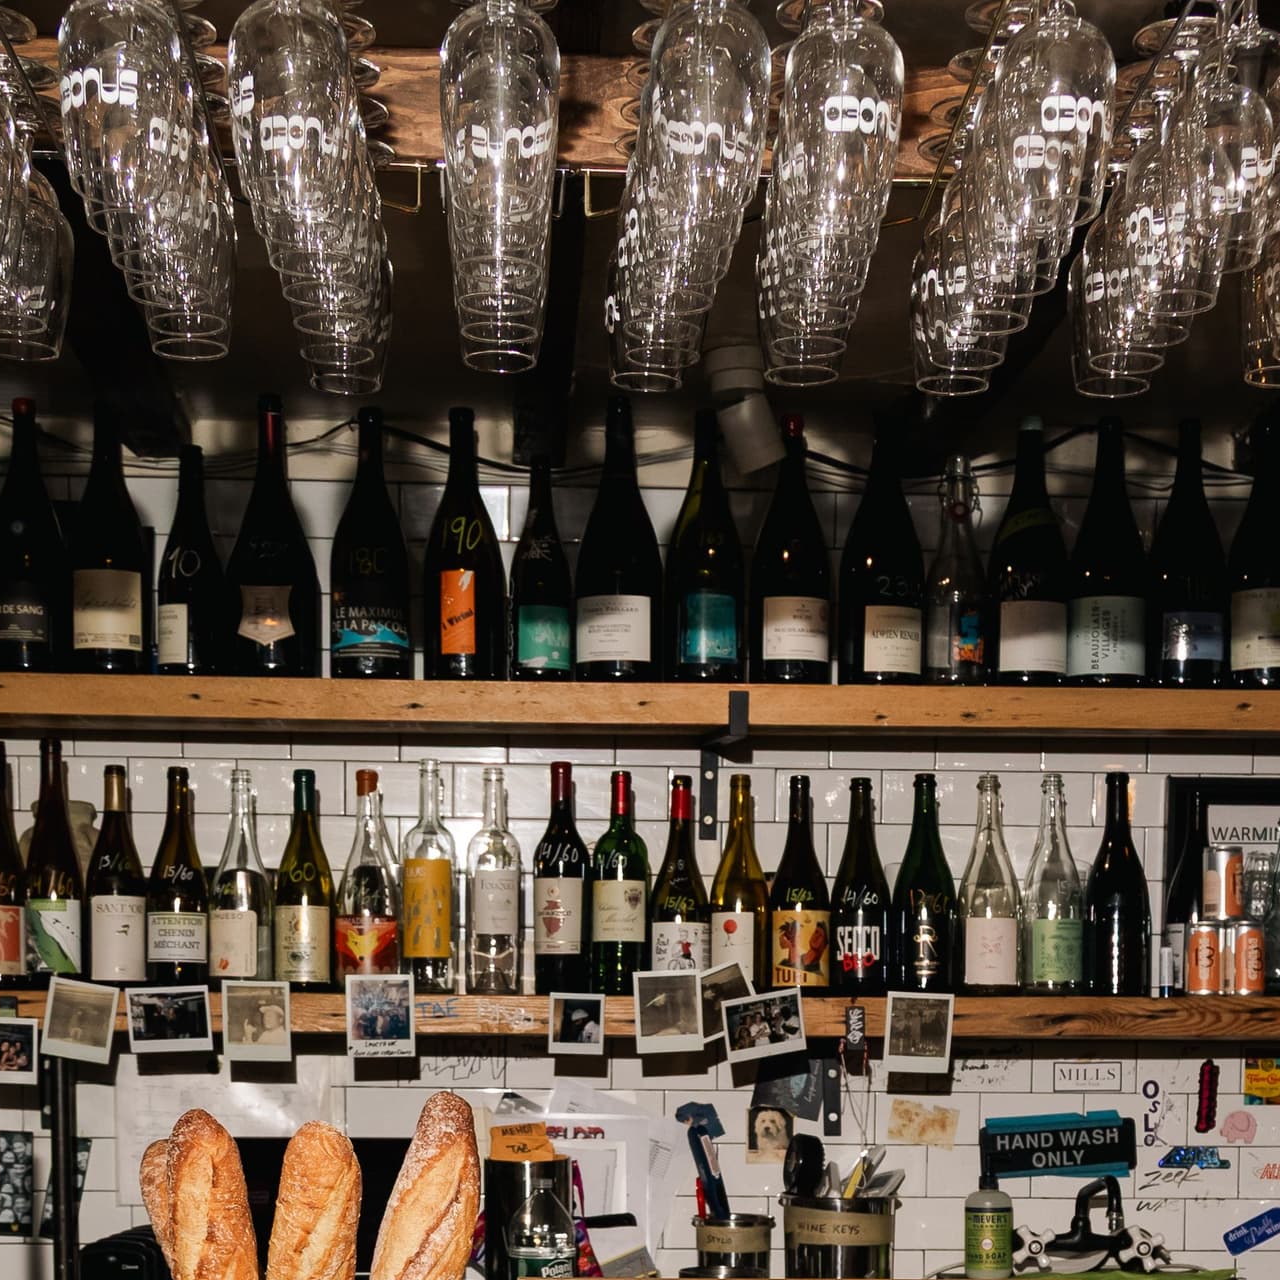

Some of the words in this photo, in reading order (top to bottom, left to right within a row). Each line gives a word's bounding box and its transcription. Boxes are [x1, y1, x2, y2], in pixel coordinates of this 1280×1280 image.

[17, 605, 43, 616] SANG
[335, 606, 347, 619] LE
[163, 864, 194, 884] 15/60
[151, 917, 203, 926] ATTENTION
[158, 928, 196, 938] CHENIN
[1059, 1067, 1116, 1081] MILLS
[996, 1132, 1055, 1151] HAND
[1059, 1128, 1119, 1147] WASH
[1032, 1150, 1085, 1168] ONLY
[797, 1223, 827, 1235] WINE
[832, 1224, 860, 1236] KEYS
